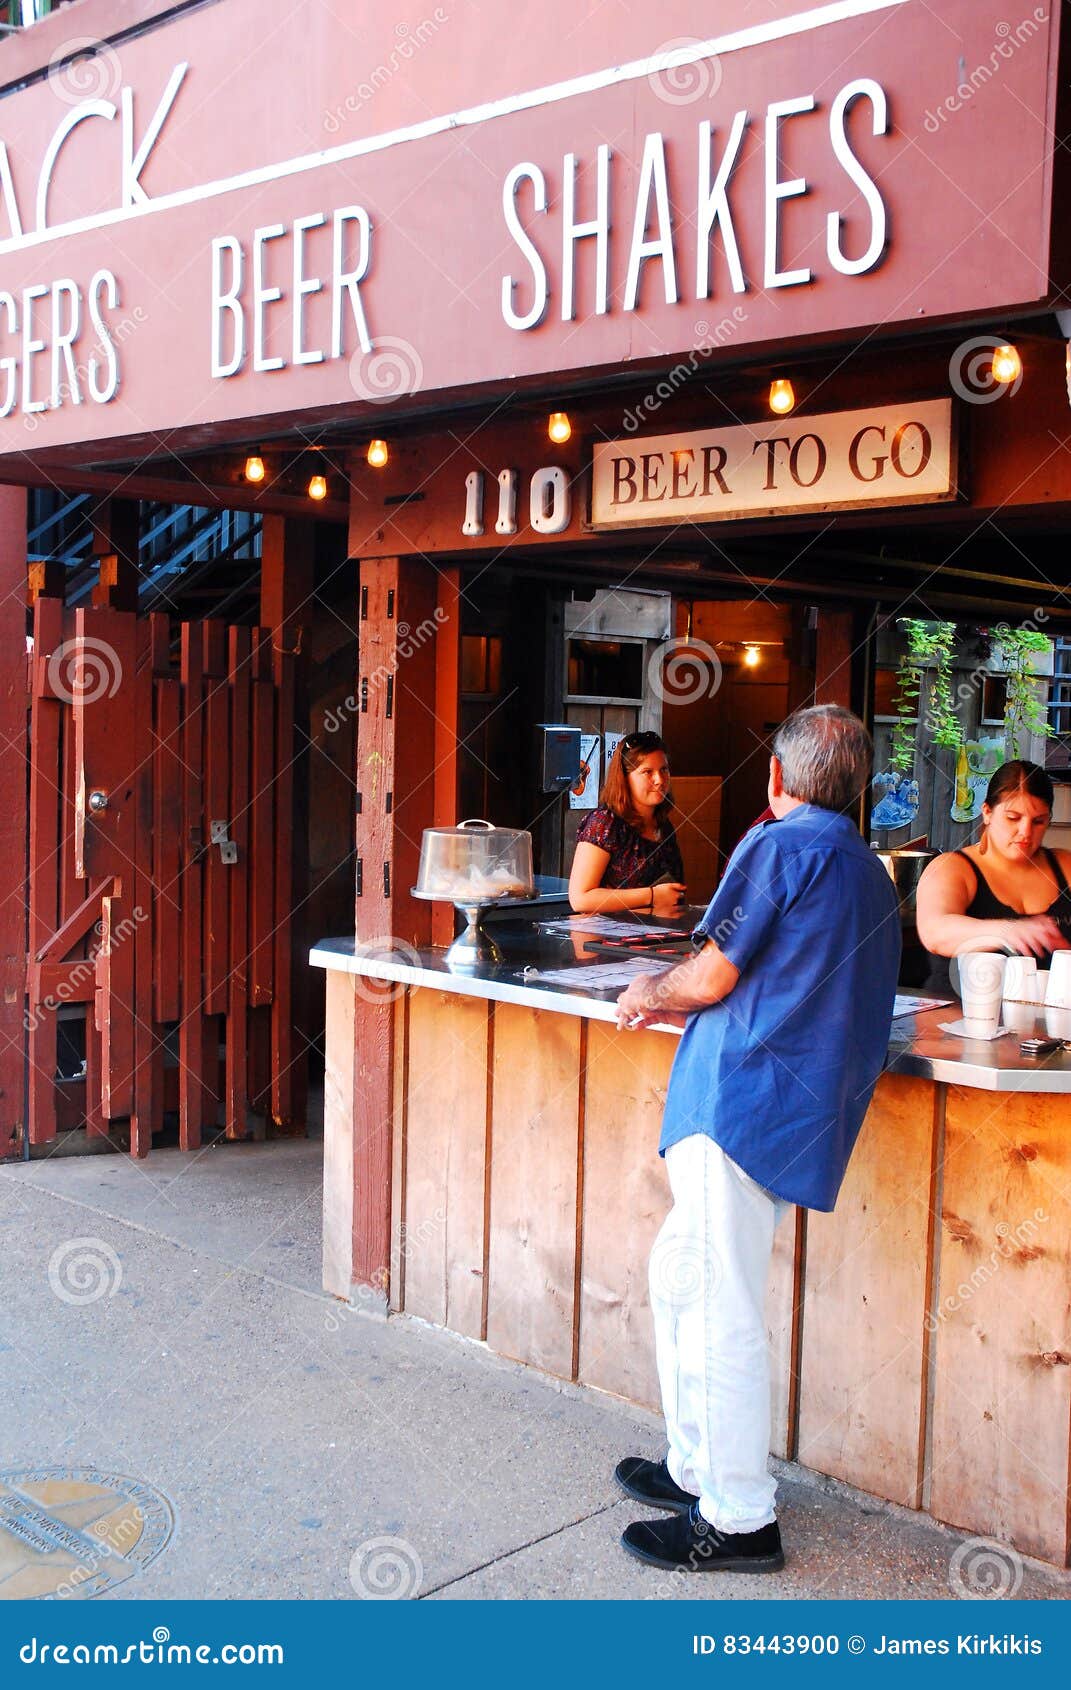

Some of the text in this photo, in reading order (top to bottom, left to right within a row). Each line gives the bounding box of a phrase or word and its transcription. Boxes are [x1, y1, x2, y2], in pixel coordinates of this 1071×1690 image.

[211, 205, 373, 378] BEER
[502, 78, 889, 332] SHAKES
[462, 466, 571, 536] 110
[609, 421, 932, 506] BEER TO GO
